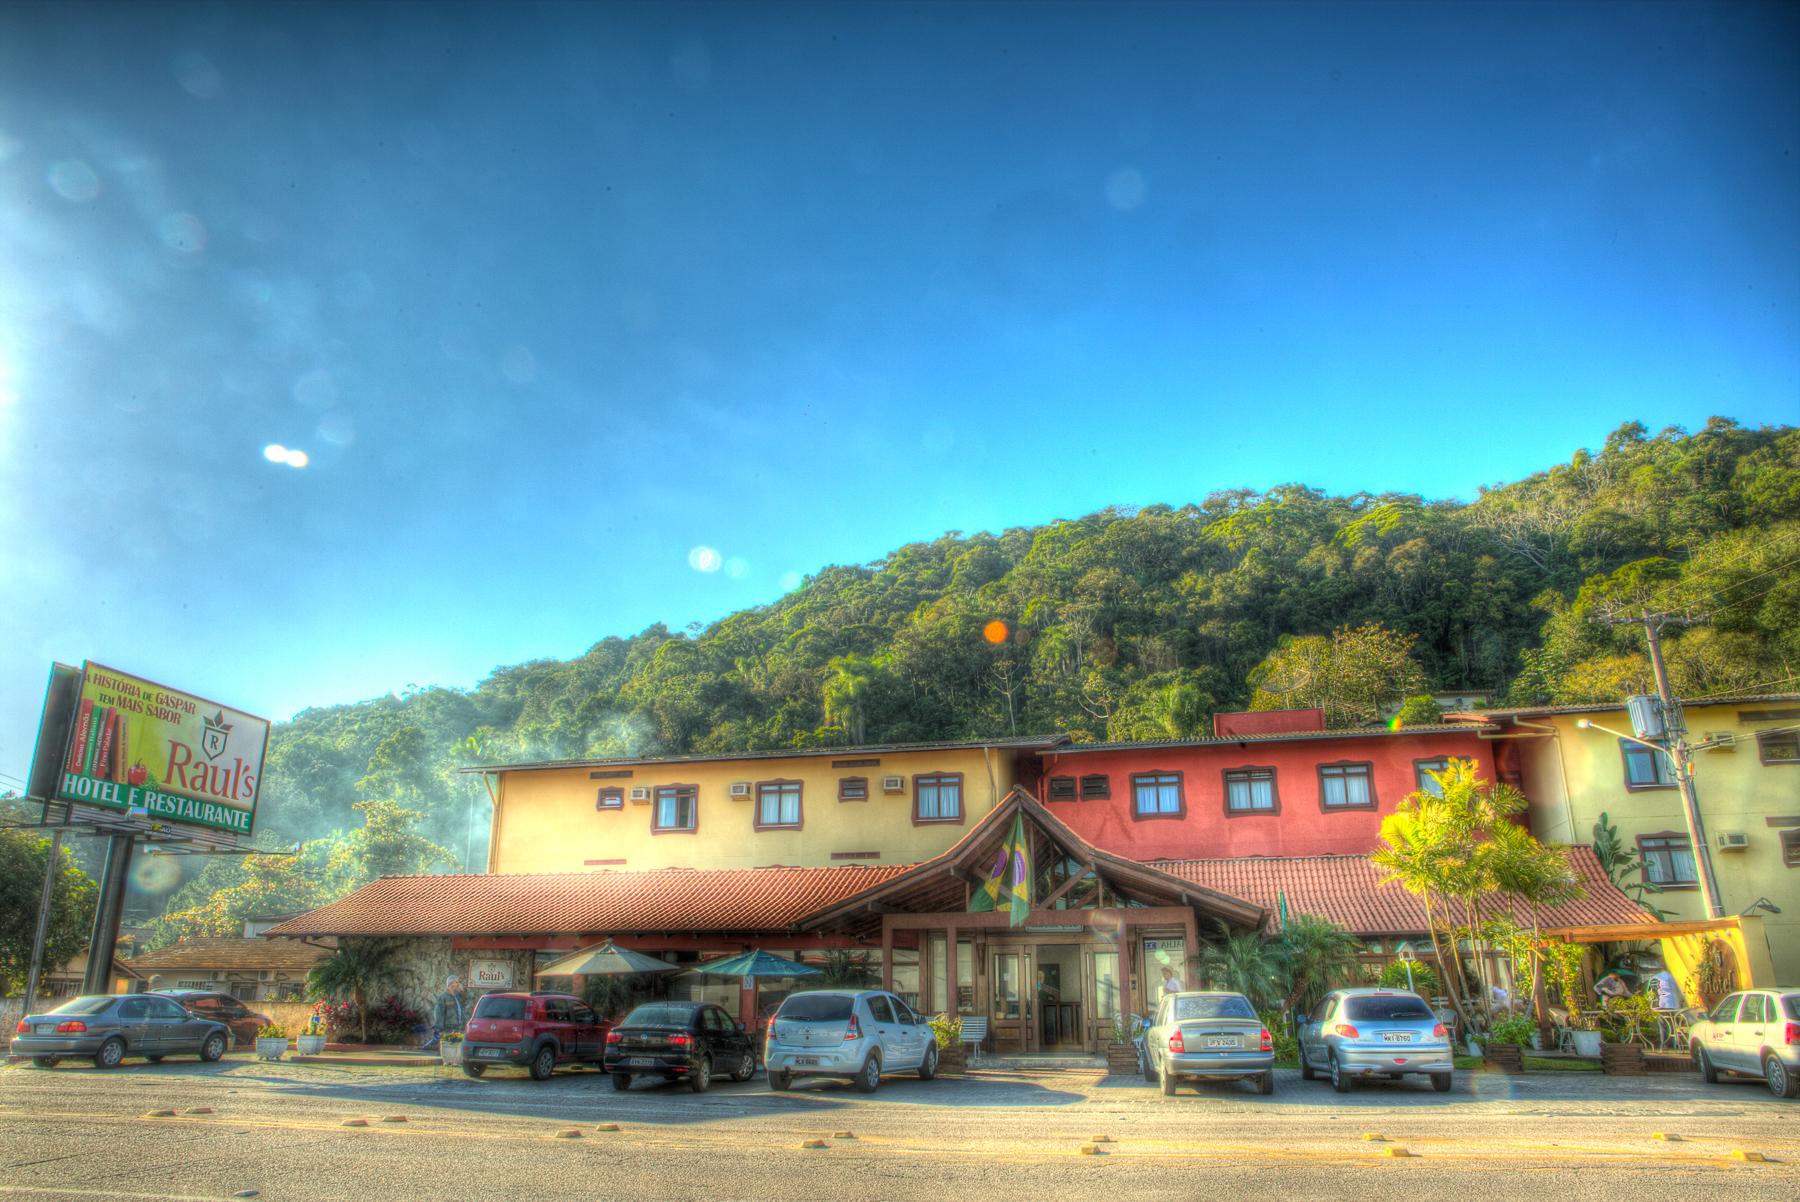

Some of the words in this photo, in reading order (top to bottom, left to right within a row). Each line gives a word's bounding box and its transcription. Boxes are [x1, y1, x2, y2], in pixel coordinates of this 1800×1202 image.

[93, 673, 141, 698] HISTÓRIA
[155, 692, 197, 715] GASPAR
[116, 695, 144, 714] MAIS
[145, 703, 182, 725] SABOR
[210, 734, 219, 750] R
[162, 739, 255, 800] Raul's
[61, 773, 122, 804] HOTEL
[128, 788, 140, 807] E
[144, 791, 251, 829] RESTAURANTE
